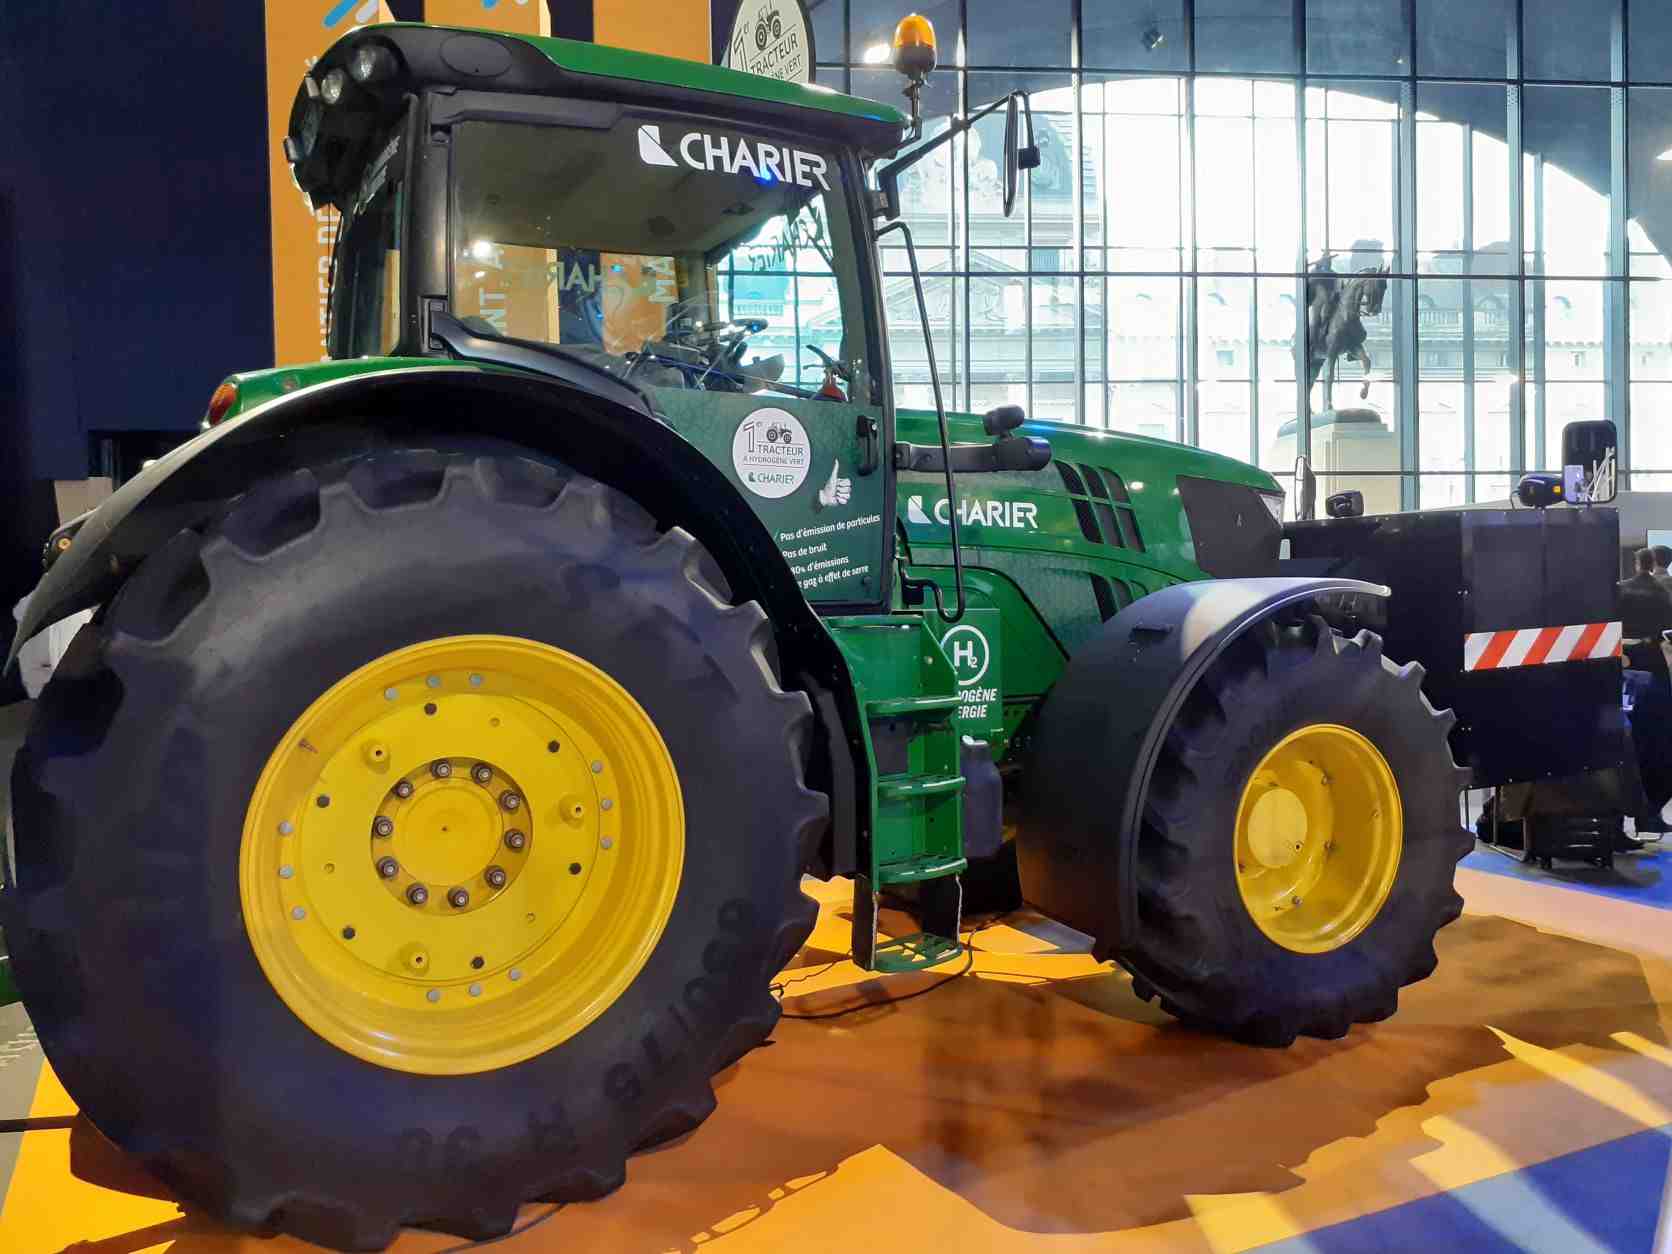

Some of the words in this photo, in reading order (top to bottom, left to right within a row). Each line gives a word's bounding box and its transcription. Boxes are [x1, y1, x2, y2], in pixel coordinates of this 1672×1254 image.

[750, 32, 798, 74] TRACTEUR
[784, 54, 801, 74] VERT
[679, 132, 831, 191] CHARIER
[758, 444, 804, 456] TRACTEUR
[757, 472, 794, 485] CHARIER
[934, 500, 1038, 529] CHARIER
[780, 532, 795, 542] Pas
[795, 523, 835, 539] d'émission
[836, 520, 846, 531] de
[846, 513, 881, 530] particules
[798, 547, 808, 557] de
[808, 542, 828, 554] bruit
[807, 555, 849, 572] d'émissions
[803, 576, 817, 589] gaz
[824, 569, 841, 582] effet
[841, 567, 851, 578] de
[851, 564, 869, 576] serre
[957, 686, 997, 703] OGÈNE
